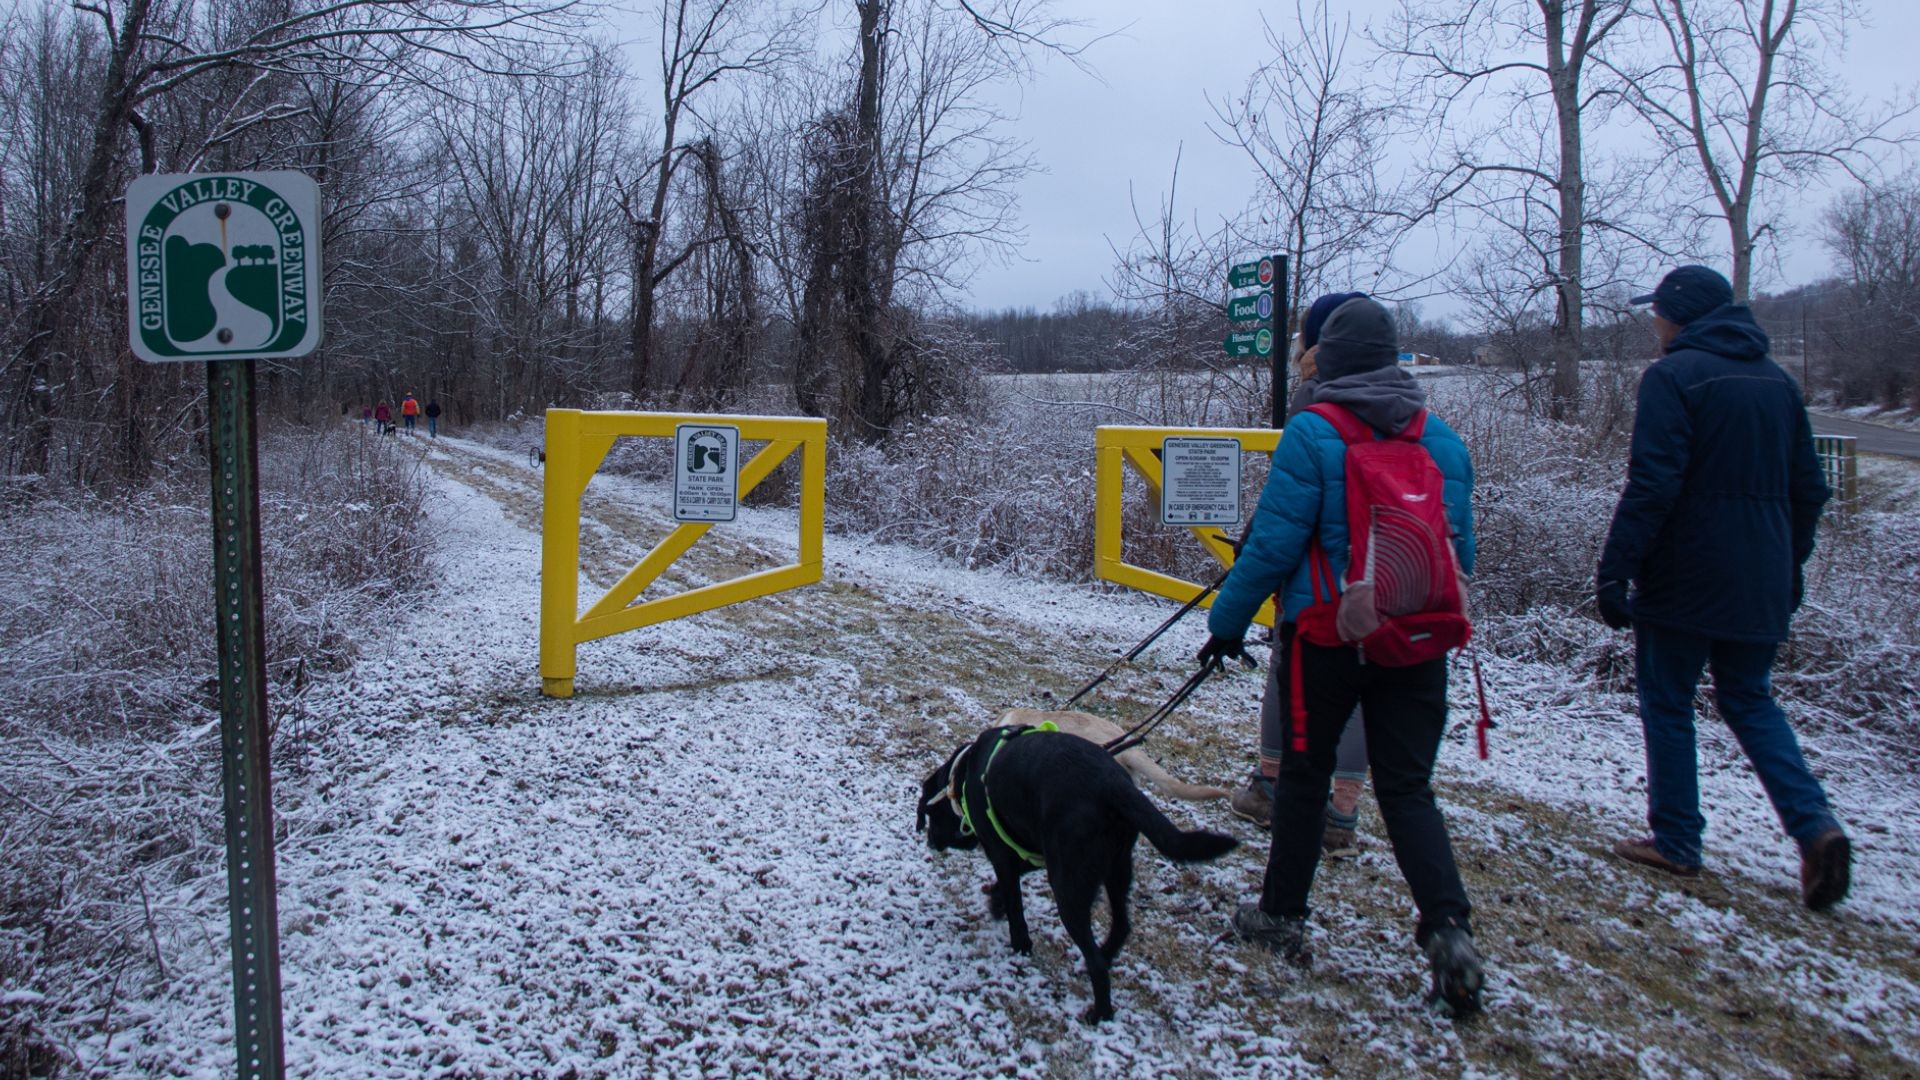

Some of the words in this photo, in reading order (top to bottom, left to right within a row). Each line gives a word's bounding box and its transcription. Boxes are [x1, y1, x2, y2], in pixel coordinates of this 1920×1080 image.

[141, 225, 163, 330] GENESEE
[161, 178, 257, 214] VALLEY
[264, 198, 305, 323] GREENWAY
[1234, 301, 1256, 317] Food
[1232, 332, 1255, 342] Historic
[1237, 345, 1249, 354] Site
[708, 475, 724, 483] PARK
